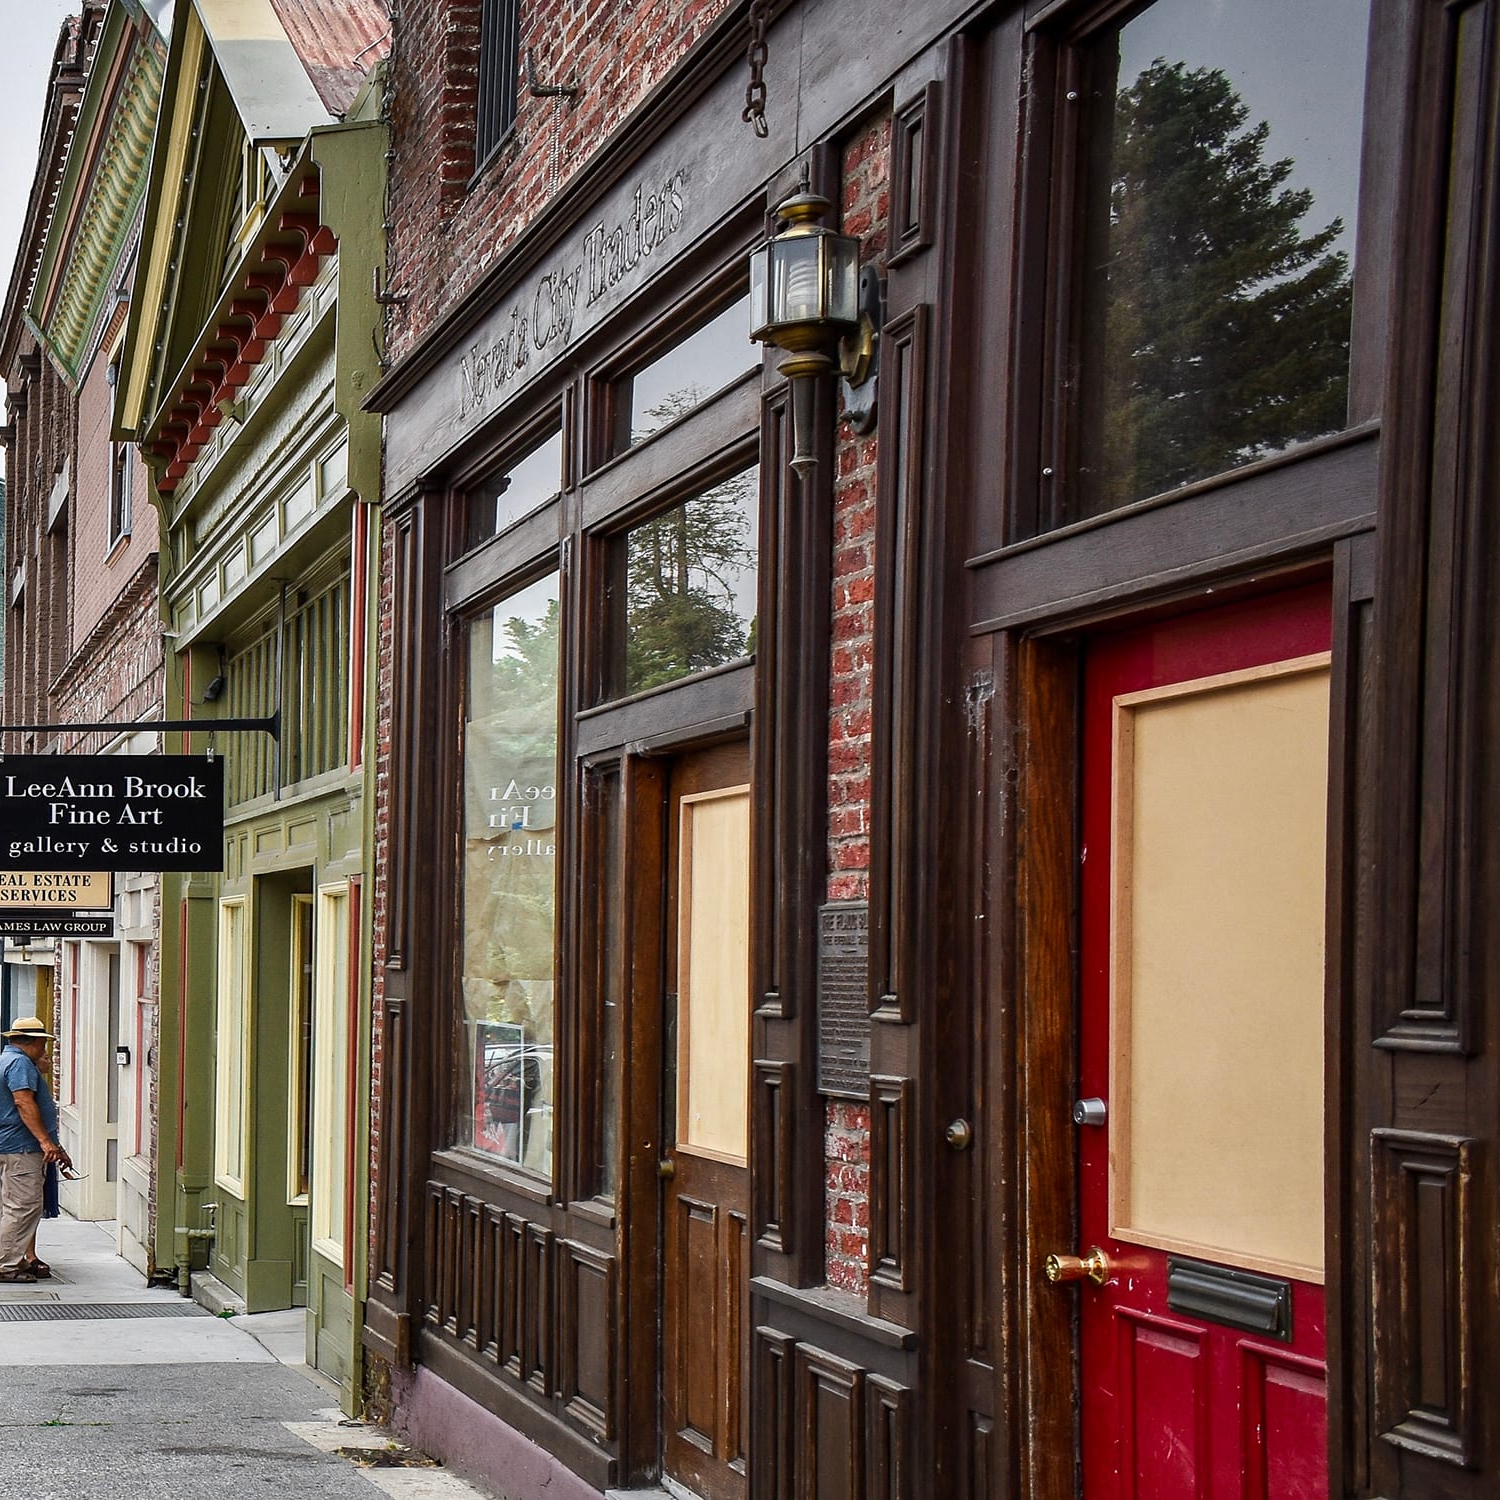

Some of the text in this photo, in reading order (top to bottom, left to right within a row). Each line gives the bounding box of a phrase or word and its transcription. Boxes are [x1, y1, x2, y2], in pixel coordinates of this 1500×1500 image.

[459, 168, 686, 420] Nevada City Traders
[5, 775, 207, 798] LeeAnn Brook
[48, 802, 163, 825] Fine Art
[8, 836, 202, 858] gallery & studio
[33, 874, 91, 887] ESTATE
[0, 889, 77, 902] SERVICES
[33, 923, 62, 931] LAW
[64, 922, 107, 932] GROUP
